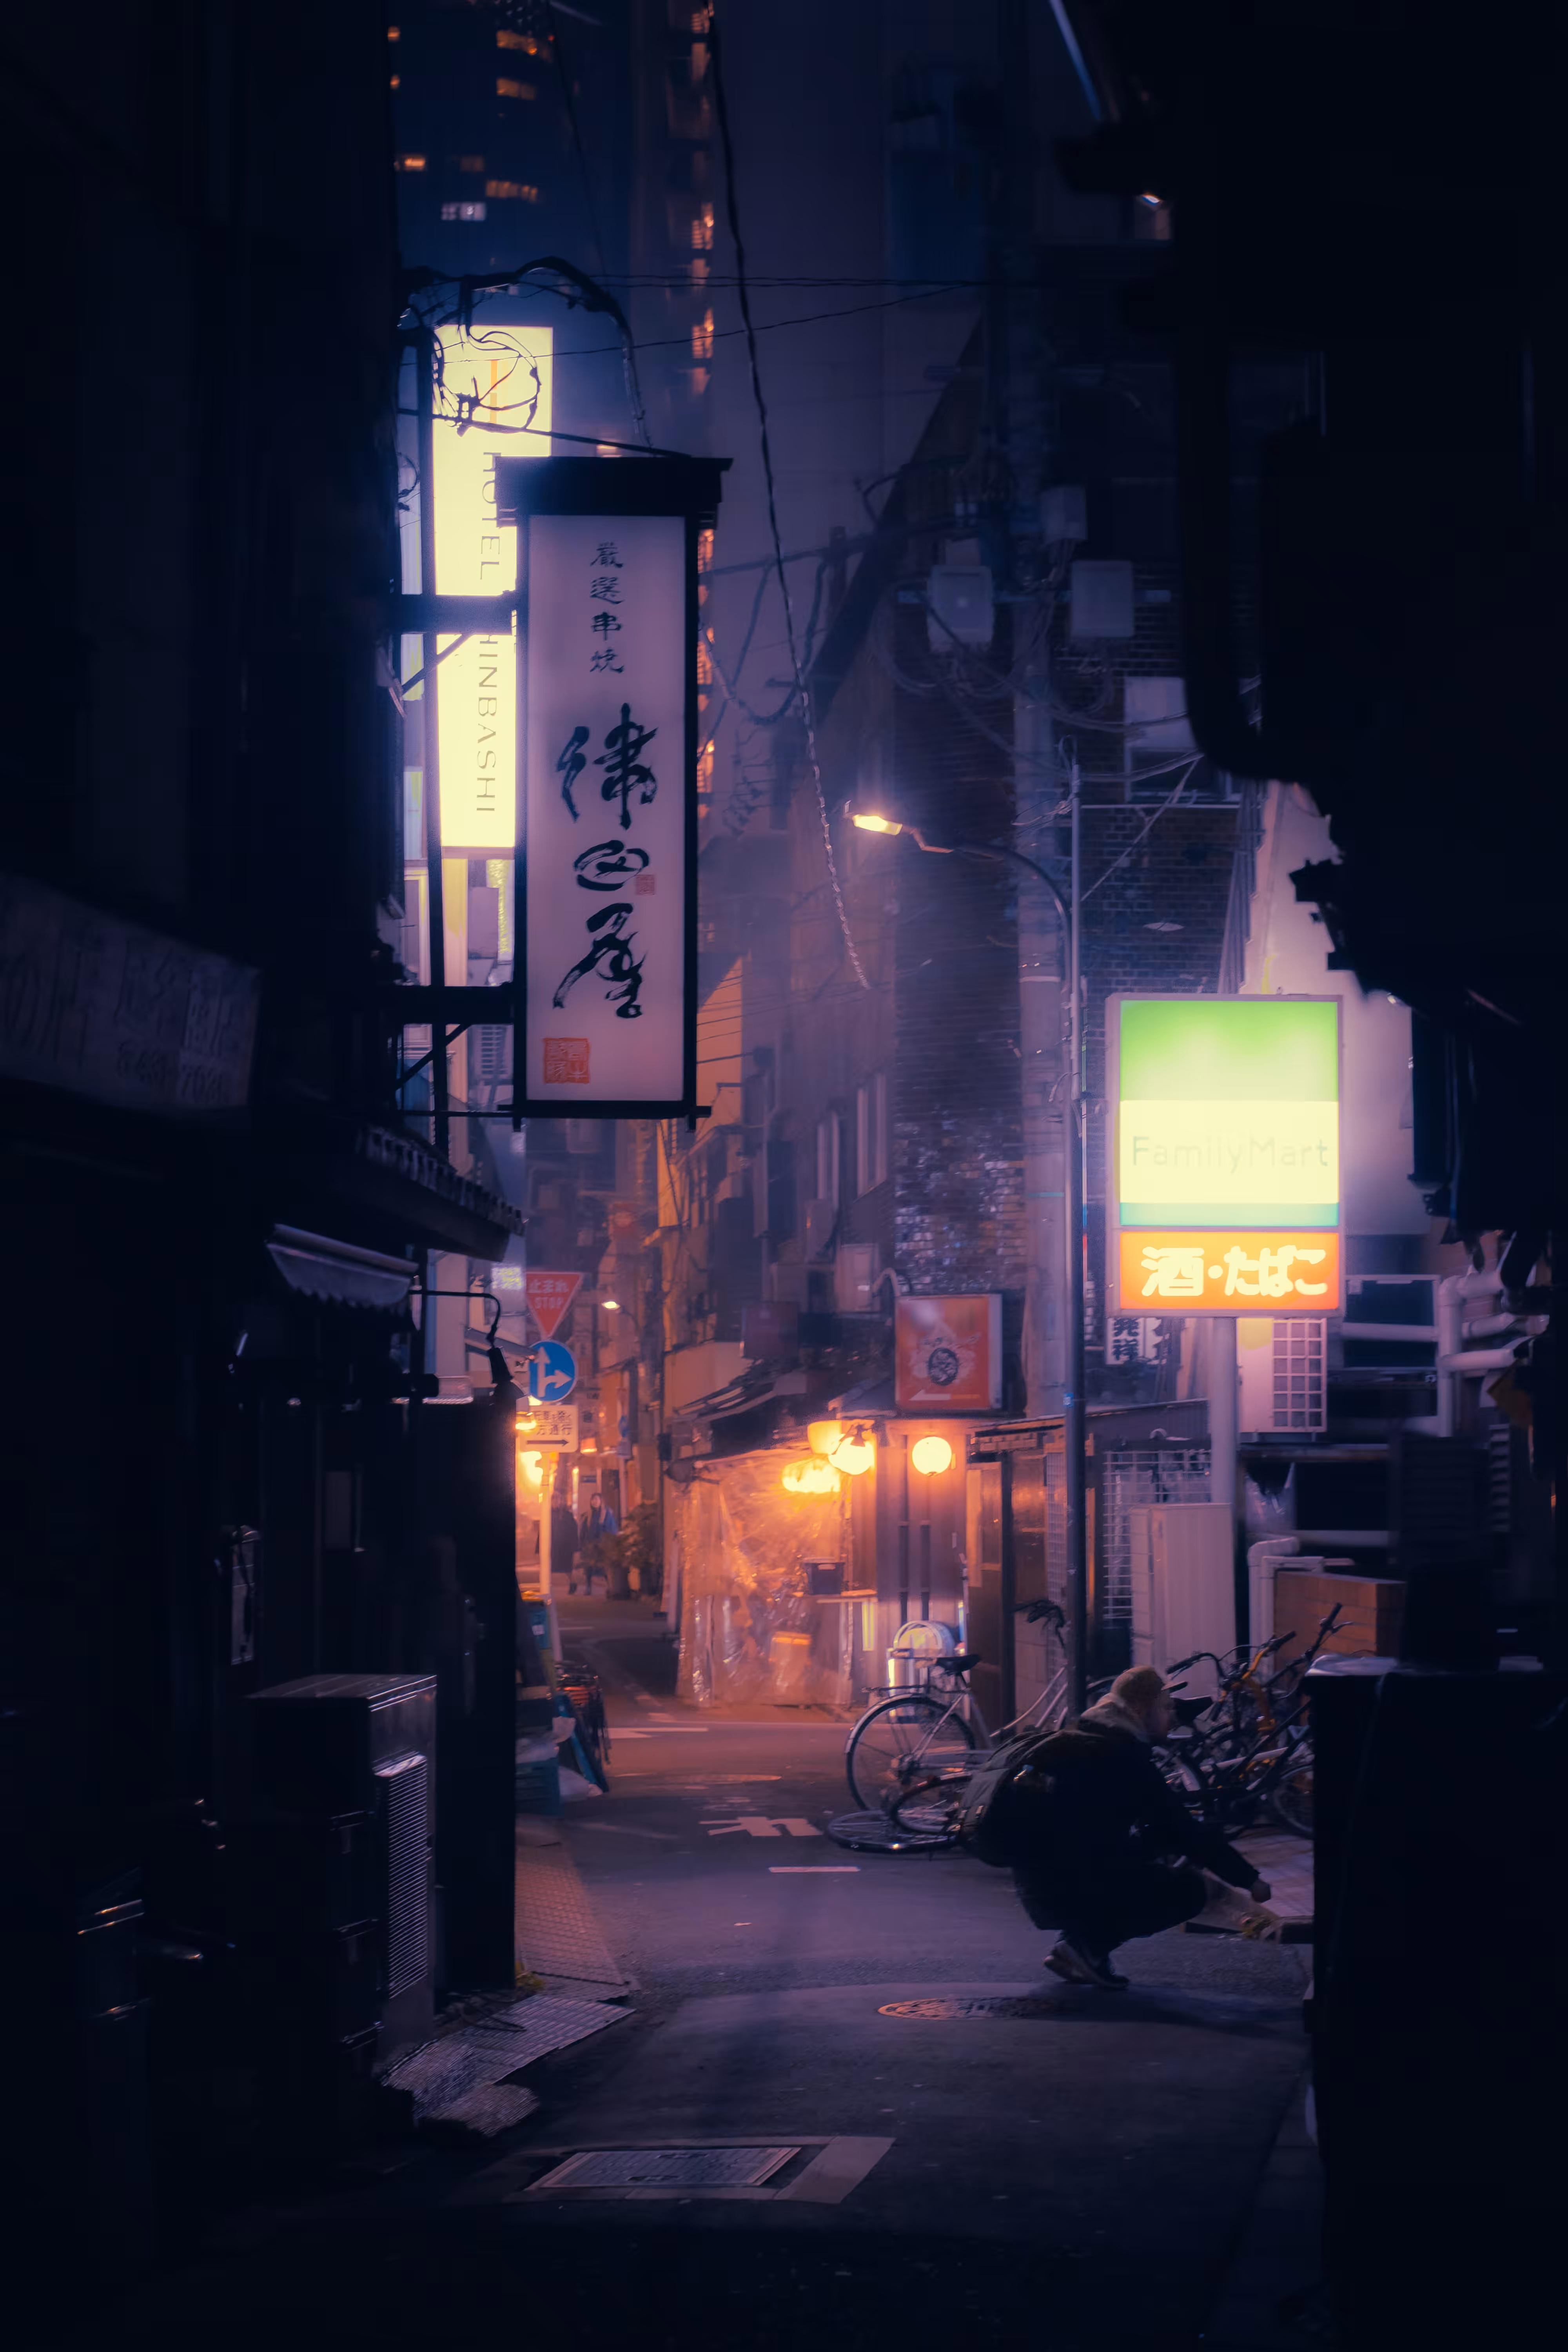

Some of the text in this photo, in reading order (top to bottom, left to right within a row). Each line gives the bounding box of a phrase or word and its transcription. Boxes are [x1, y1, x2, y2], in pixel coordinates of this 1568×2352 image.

[476, 635, 498, 811] HINBASHI
[1133, 1135, 1328, 1174] FamilyMart
[1141, 1245, 1328, 1297] 酒・たばこ
